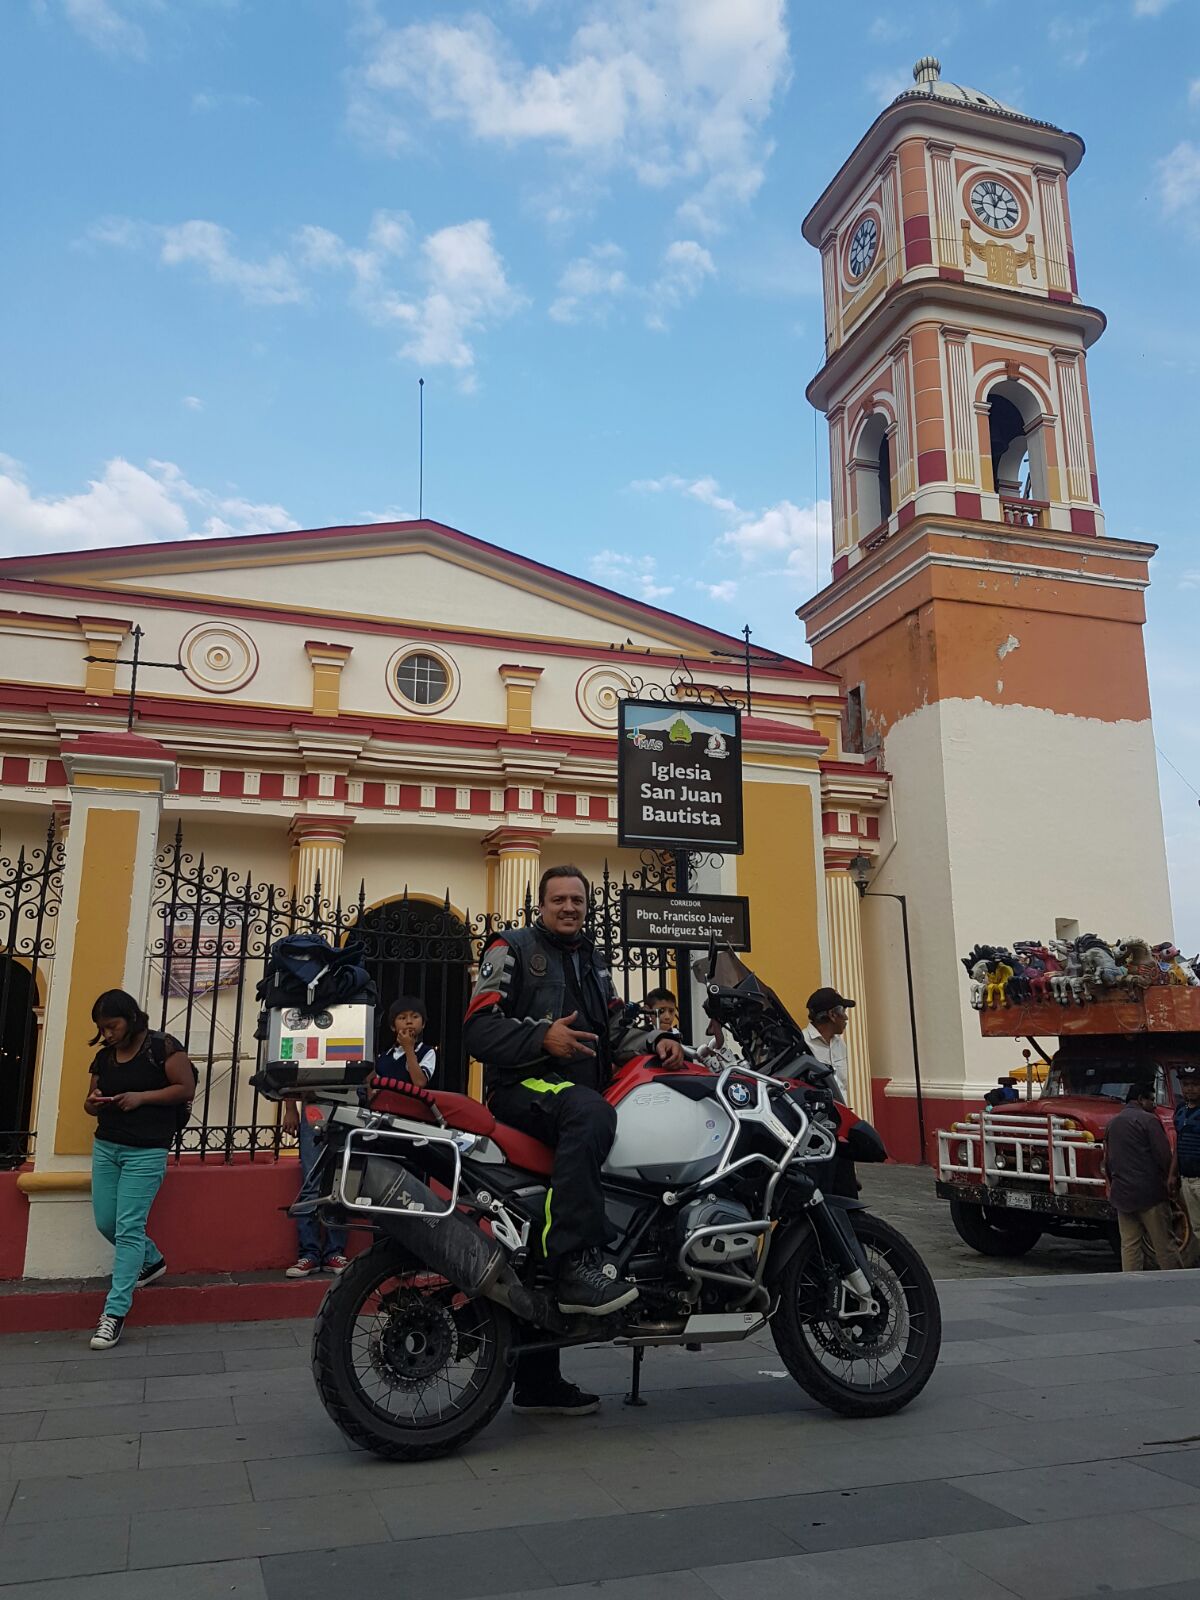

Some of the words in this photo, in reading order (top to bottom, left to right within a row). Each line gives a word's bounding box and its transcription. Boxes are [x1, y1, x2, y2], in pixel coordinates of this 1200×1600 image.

[651, 761, 712, 782] Iglesia
[640, 782, 676, 800] San
[680, 785, 722, 804] Juan
[642, 805, 722, 826] Bautista
[670, 899, 702, 908] CORREDOR
[636, 909, 661, 920] Pbro.
[663, 910, 706, 922] Francisco
[707, 913, 735, 924] Javier
[649, 923, 696, 937] Rodríguez
[698, 925, 723, 937] Sainz
